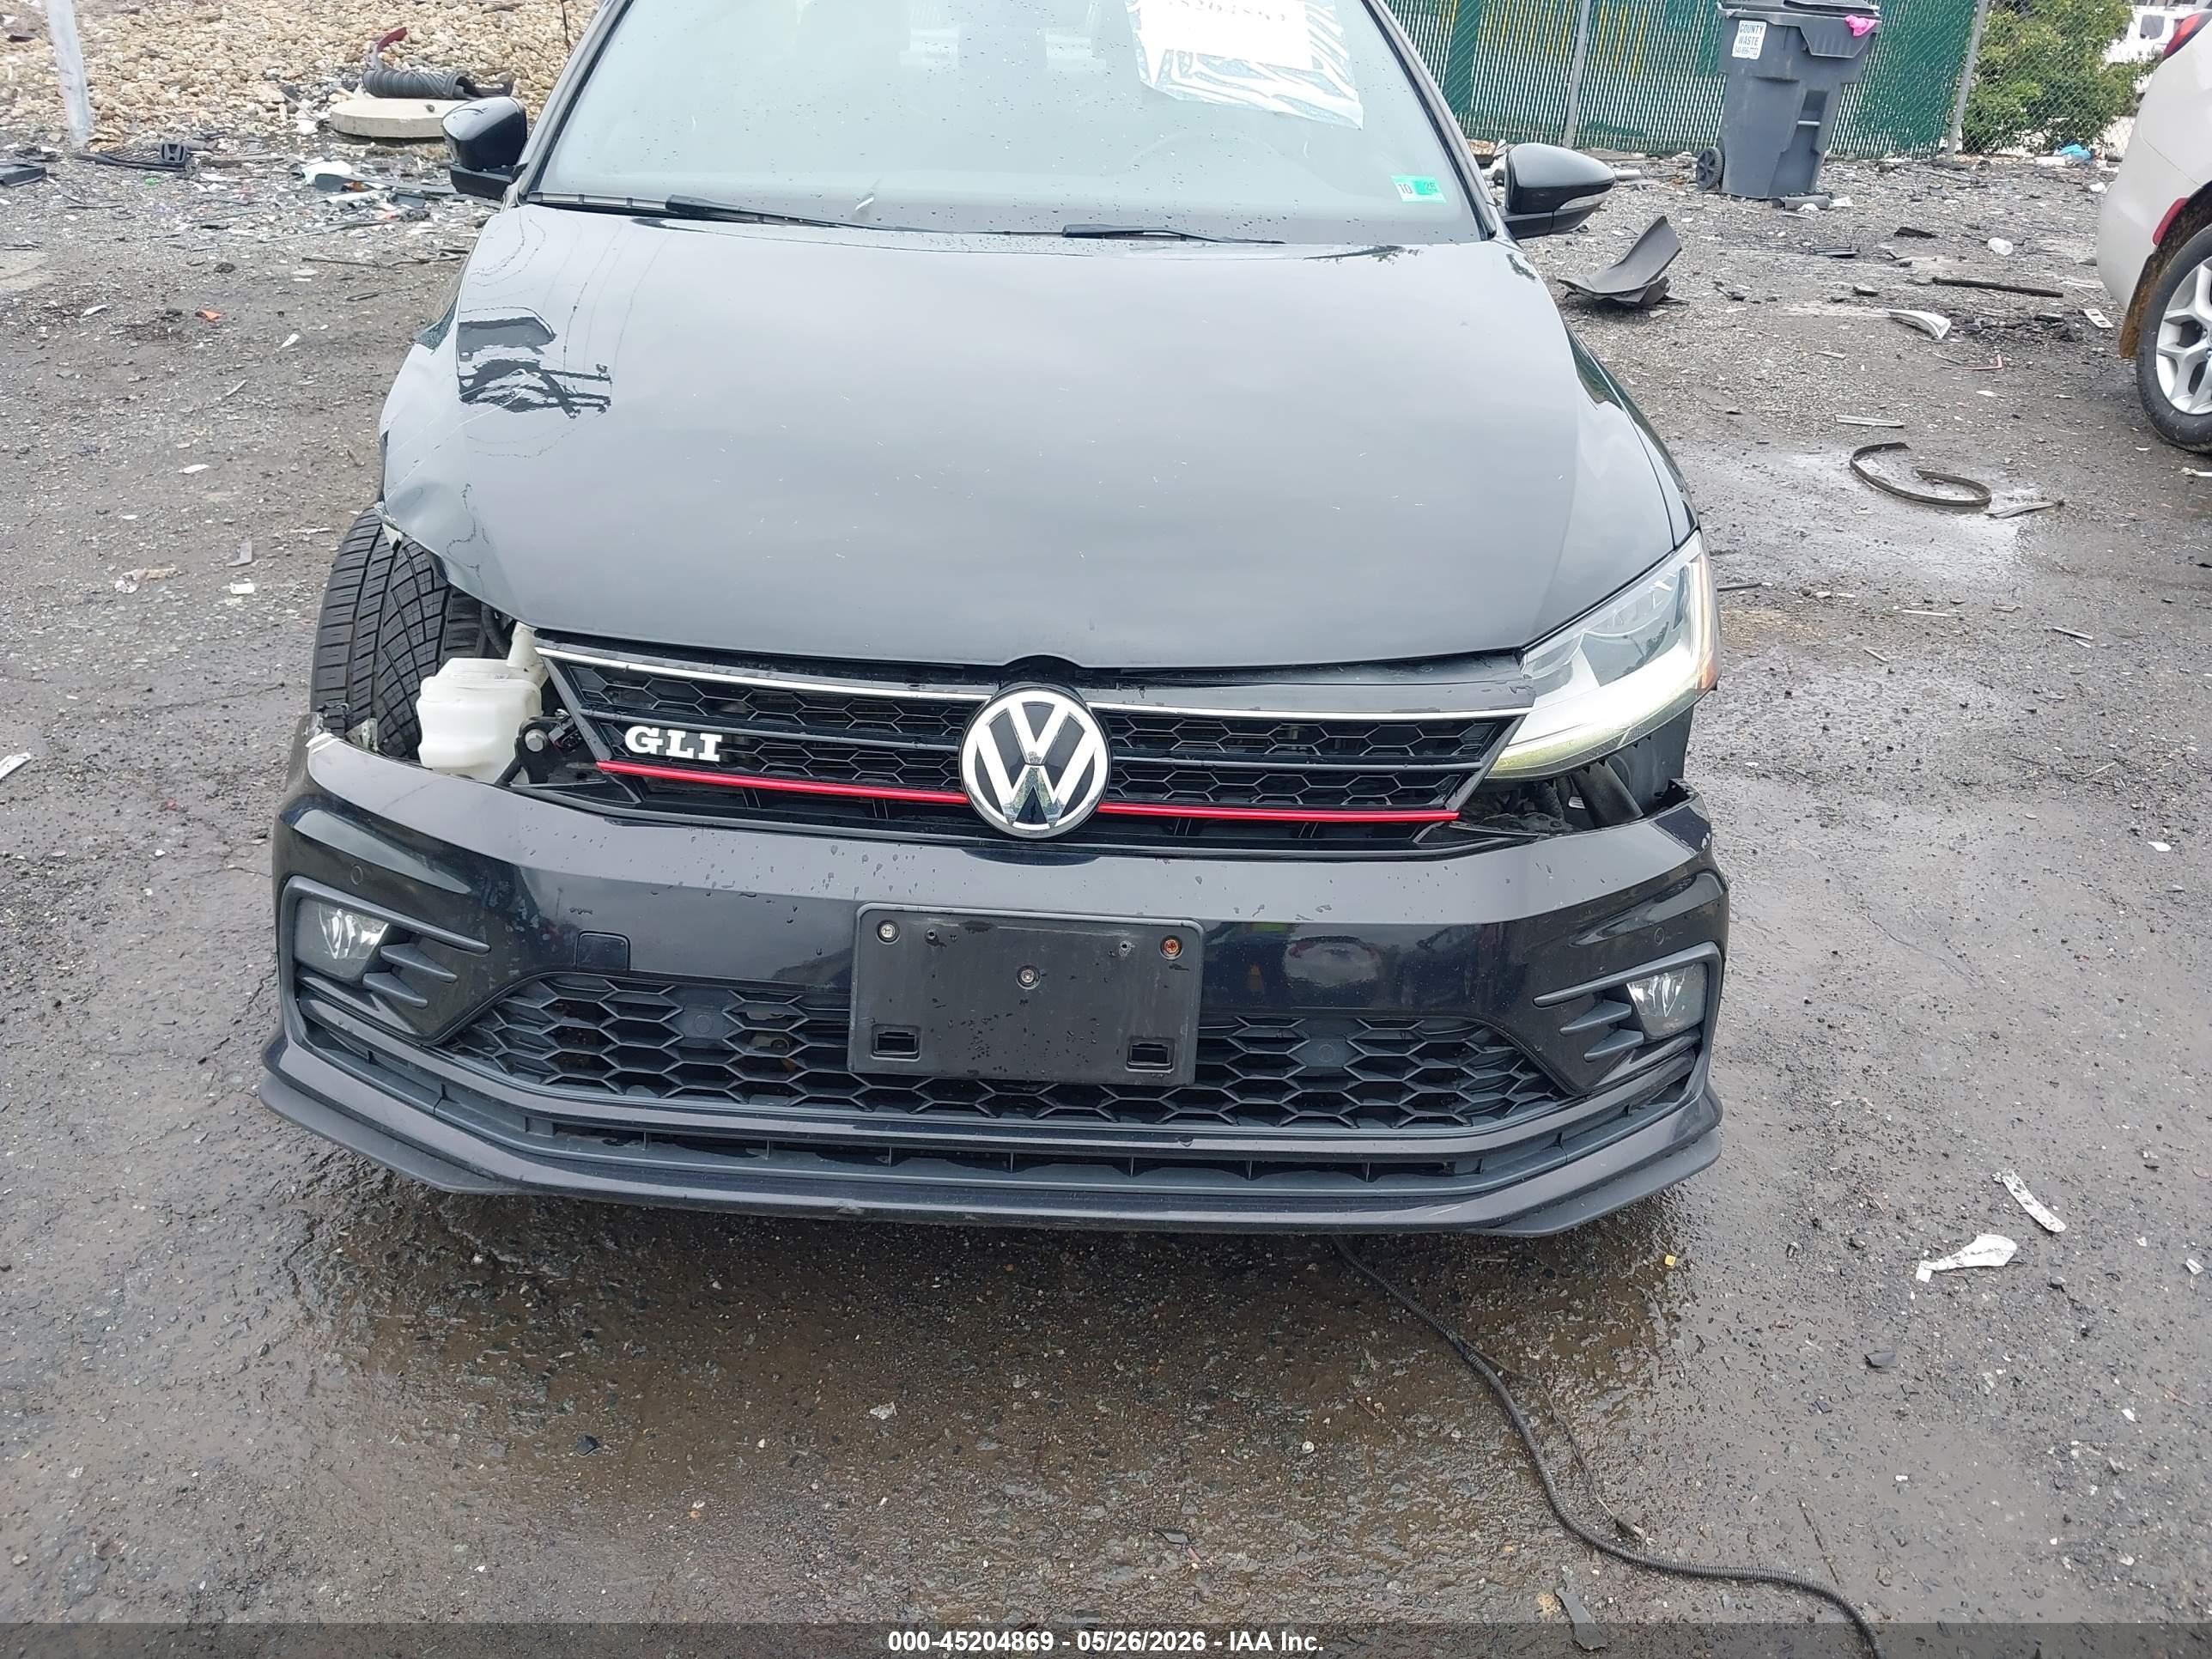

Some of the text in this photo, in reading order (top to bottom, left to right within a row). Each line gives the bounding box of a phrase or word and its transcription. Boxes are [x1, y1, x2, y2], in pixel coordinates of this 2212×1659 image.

[1739, 24, 1764, 34] COUNTY
[1738, 35, 1759, 46] WASTE
[623, 725, 724, 763] GLI
